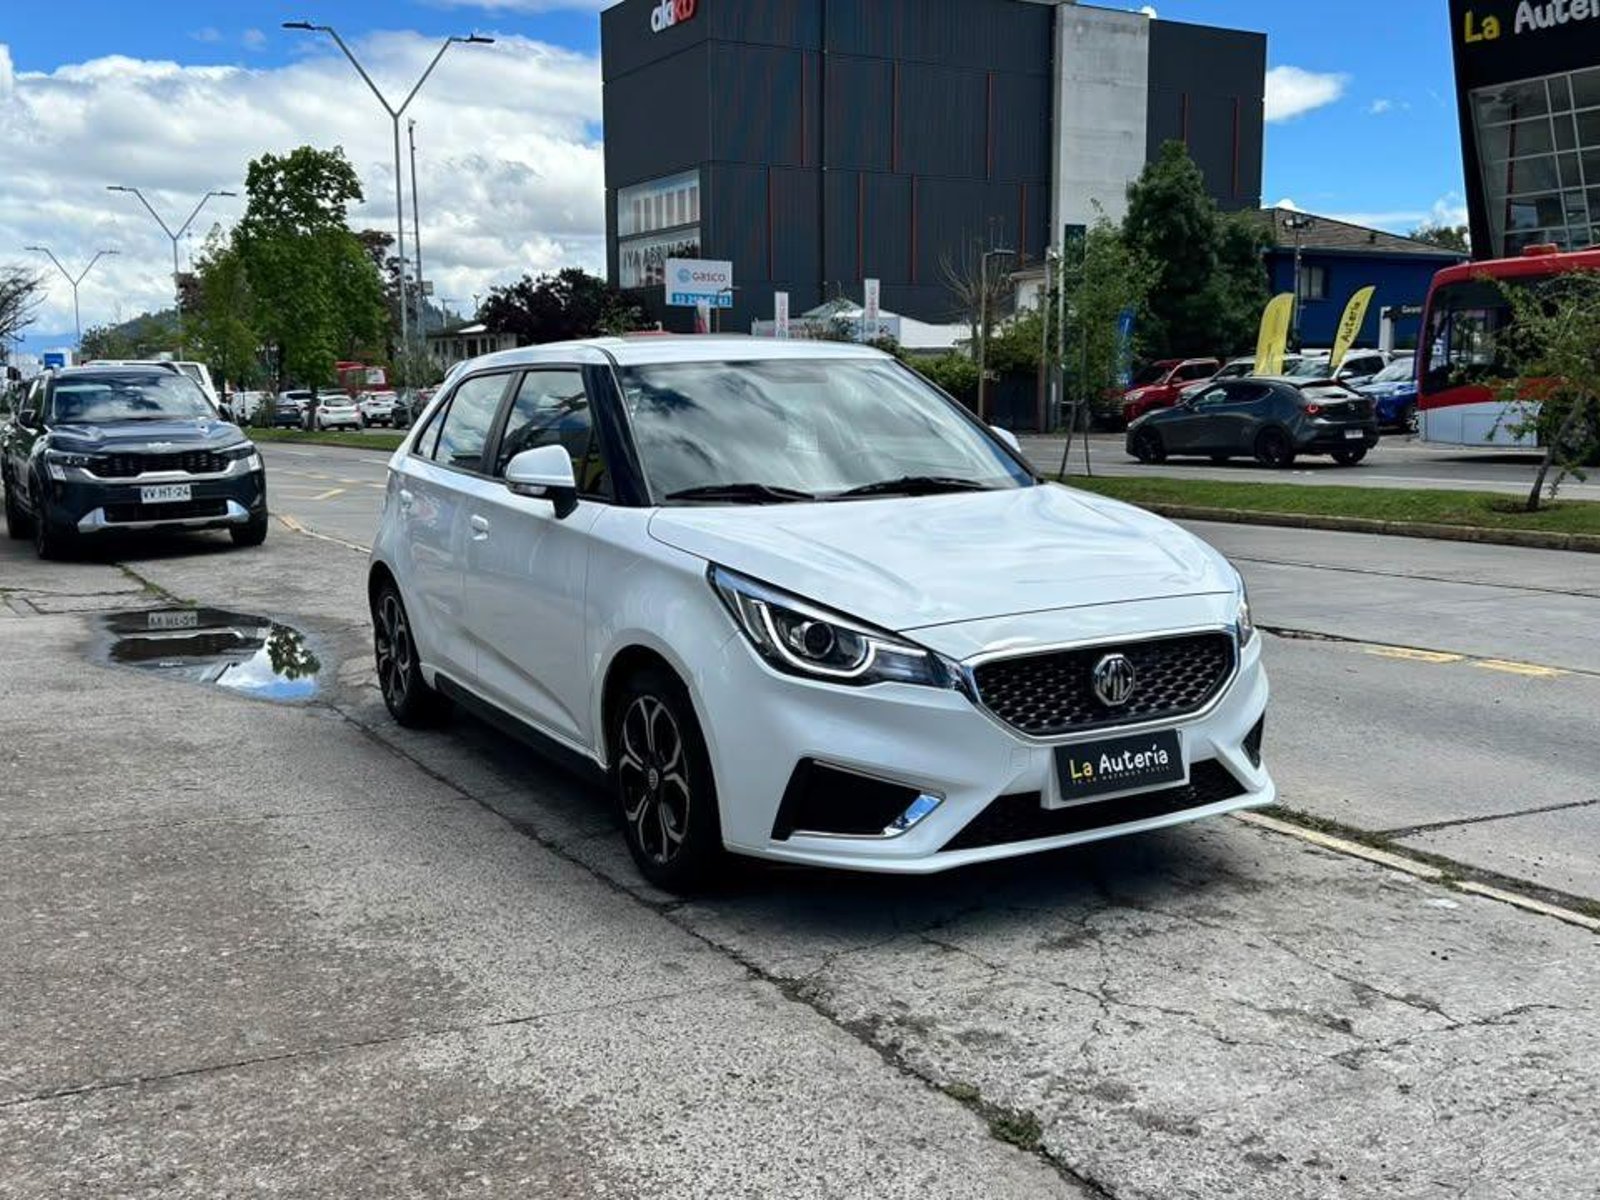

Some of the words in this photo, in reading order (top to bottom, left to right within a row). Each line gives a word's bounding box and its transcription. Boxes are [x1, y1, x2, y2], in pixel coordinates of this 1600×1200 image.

[1464, 10, 1500, 43] La
[1101, 658, 1133, 702] MG
[1068, 759, 1093, 779] La
[1099, 743, 1169, 774] Autería
